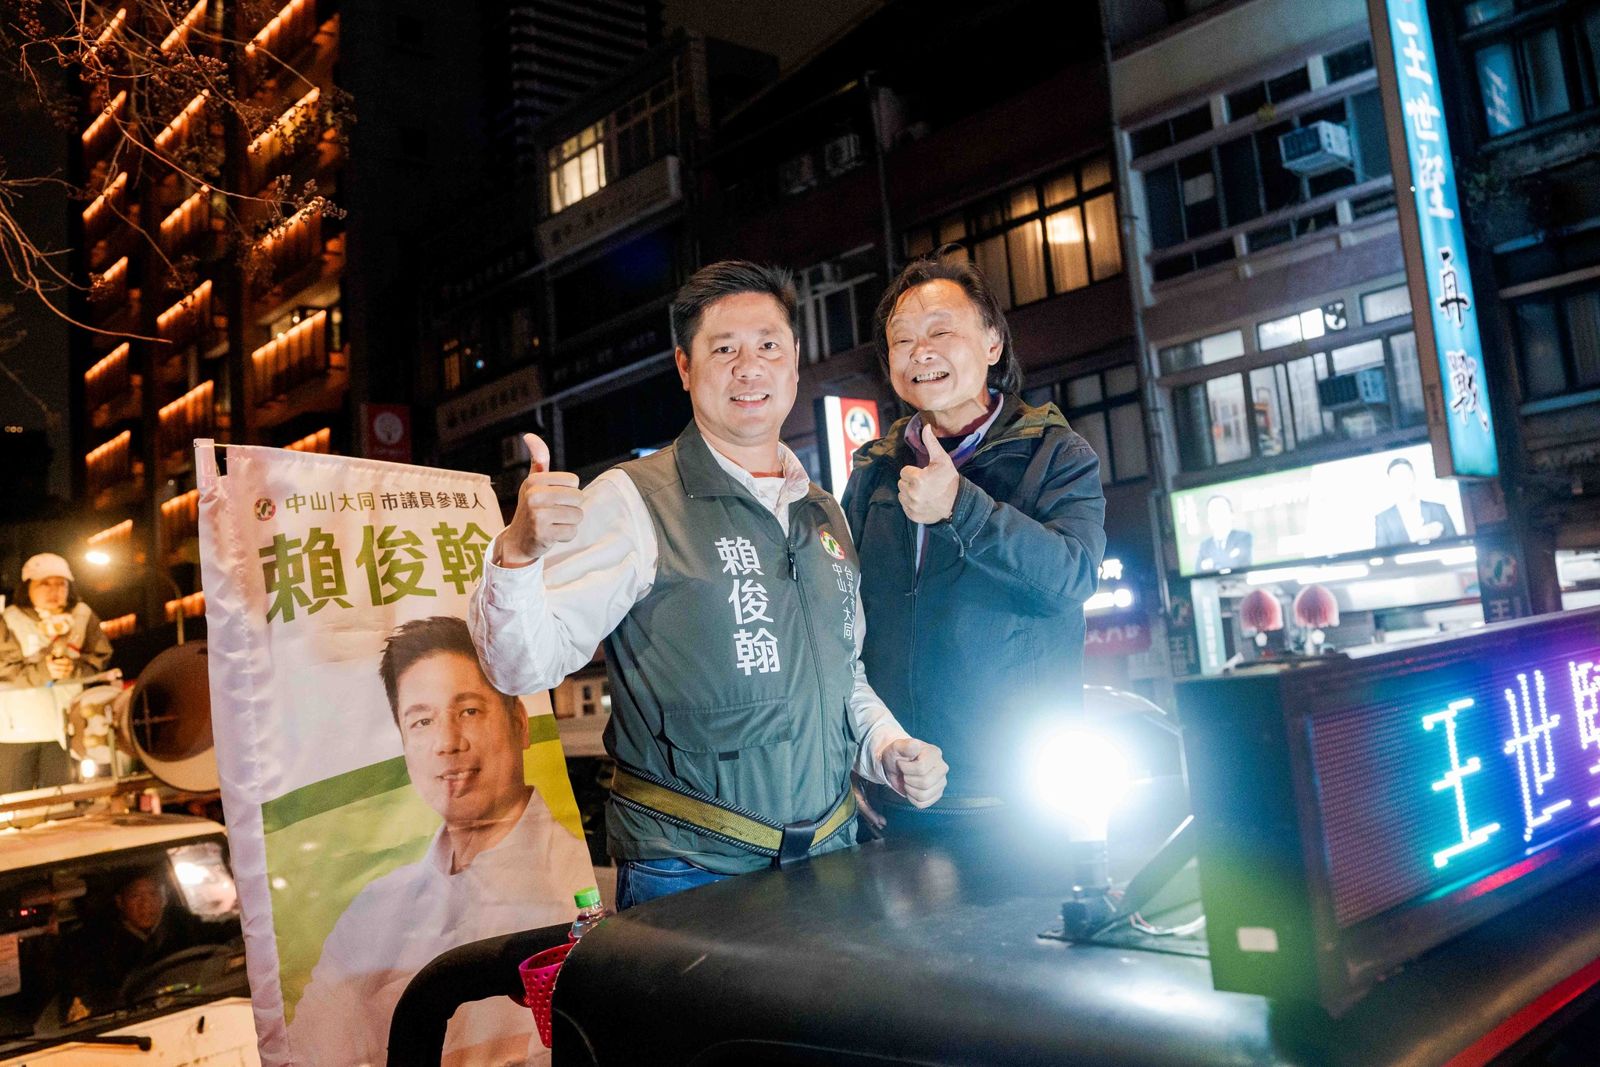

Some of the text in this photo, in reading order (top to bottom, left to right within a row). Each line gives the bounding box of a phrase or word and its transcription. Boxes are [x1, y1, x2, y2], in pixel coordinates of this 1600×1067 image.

[380, 491, 486, 511] 市議員參選人
[714, 536, 781, 676] 賴俊翰
